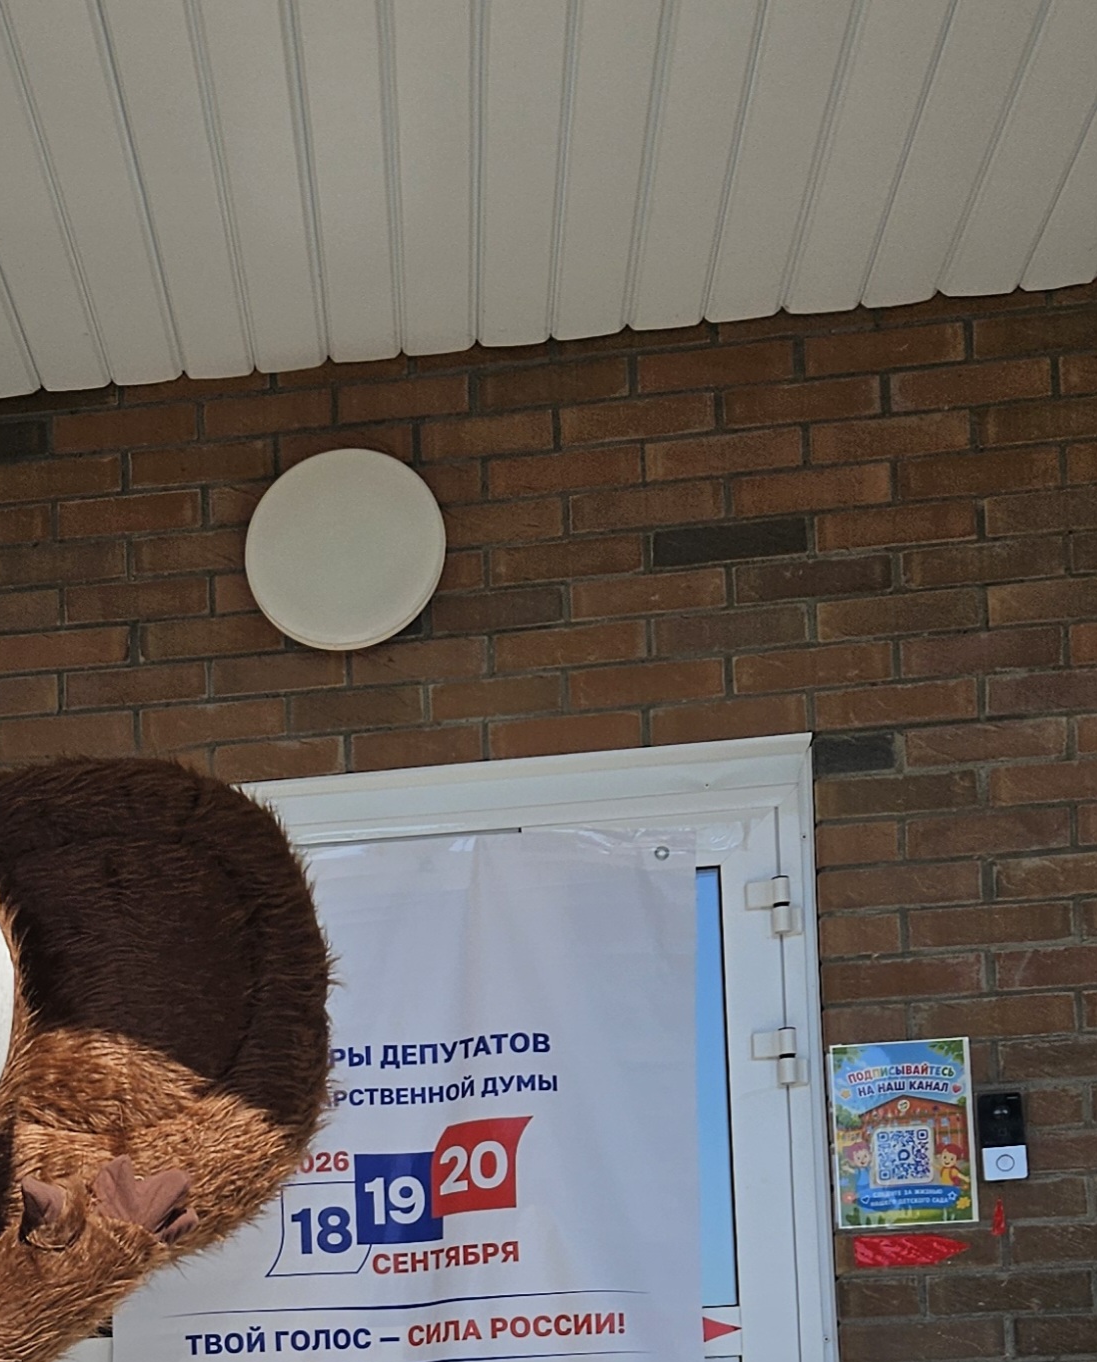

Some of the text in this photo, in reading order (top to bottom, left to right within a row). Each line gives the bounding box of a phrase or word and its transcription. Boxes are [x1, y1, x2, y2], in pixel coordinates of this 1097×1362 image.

[330, 1032, 551, 1069] РЫ ДЕПУТАТОВ
[848, 1063, 955, 1084] ПОДПИСЫВАЙТЕСЬ
[858, 1080, 949, 1097] НА НАШ КАНАЛ
[330, 1075, 558, 1107] РСТВЕННОЙ ДУМЫ
[298, 1150, 350, 1174] 026
[291, 1140, 508, 1255] 18 19 20
[372, 1241, 520, 1275] СЕНТЯБРЯ
[186, 1325, 266, 1355] ТВОЙ
[275, 1328, 372, 1353] ГОЛОС
[407, 1317, 482, 1347] СИЛА
[490, 1312, 626, 1340] РОССИИ!
